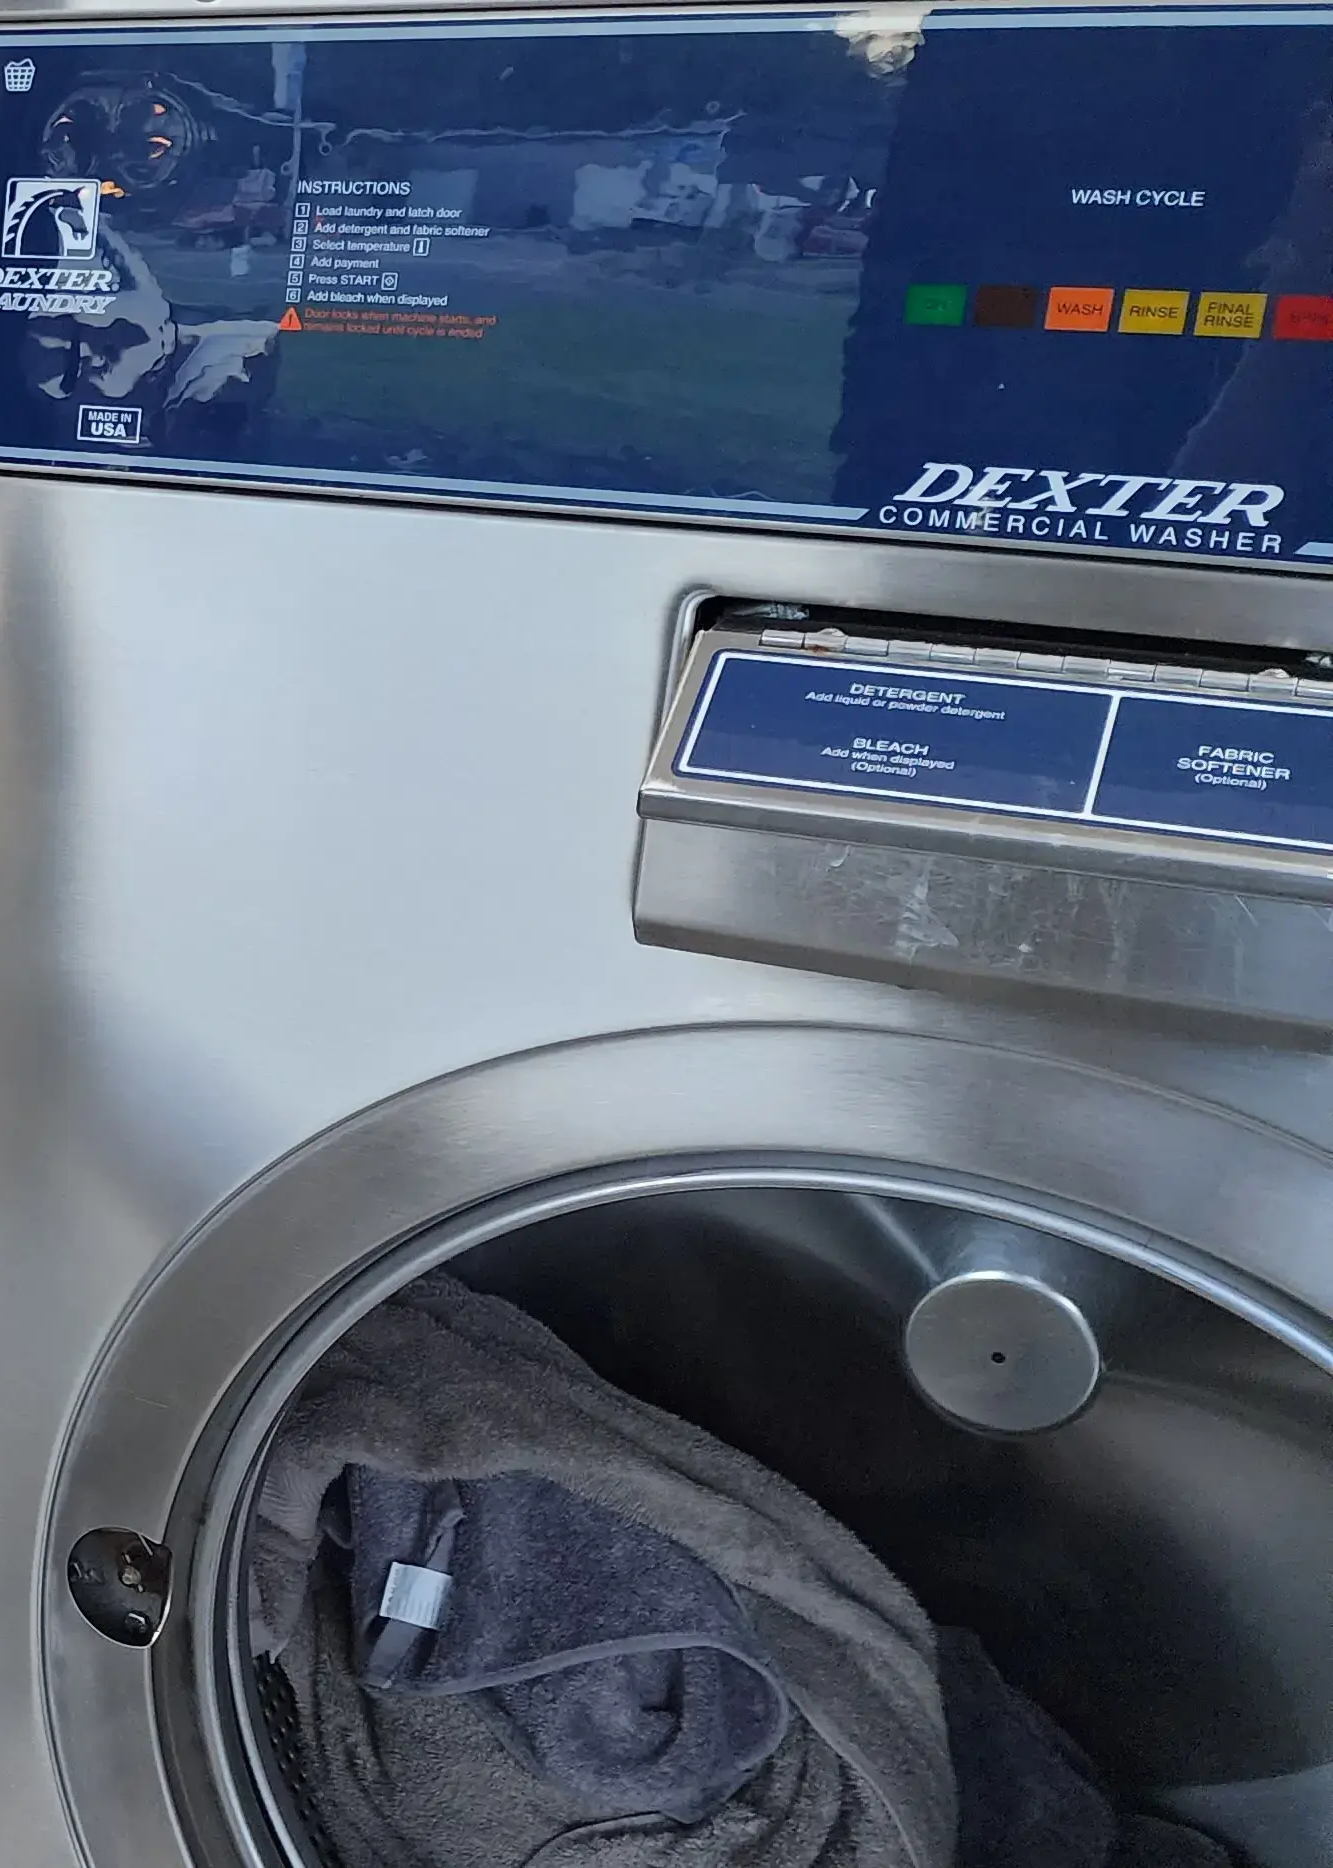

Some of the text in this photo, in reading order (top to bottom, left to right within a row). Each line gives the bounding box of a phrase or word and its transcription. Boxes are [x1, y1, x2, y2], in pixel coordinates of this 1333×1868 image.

[297, 180, 411, 196] INSTRUCTIONS
[1071, 187, 1206, 208] WASH CYCLE
[316, 206, 342, 217] Load
[344, 207, 383, 220] laundry
[386, 208, 406, 218] and
[408, 208, 434, 219] latch
[436, 208, 462, 219] door
[314, 223, 336, 234] Add
[338, 224, 387, 237] detergent
[390, 225, 410, 235] and
[412, 225, 443, 236] fabric
[445, 226, 491, 237] softener
[312, 239, 345, 251] Select
[347, 240, 410, 253] temperature
[310, 256, 332, 268] Add
[334, 258, 380, 271] payment
[308, 274, 338, 285] Press
[340, 275, 379, 286] START
[306, 290, 328, 302] Add
[330, 292, 365, 303] bleach
[366, 293, 395, 304] when
[397, 294, 448, 307] displayed
[304, 308, 330, 319] Door
[332, 309, 358, 320] locks
[361, 310, 389, 321] when
[391, 311, 436, 323] machine
[475, 314, 497, 325] and
[1055, 301, 1104, 317] WASH
[1128, 303, 1179, 320] RINSE
[1206, 300, 1255, 316] FINAL
[1203, 313, 1254, 330] RINSE
[346, 323, 382, 334] locked
[382, 324, 406, 335] until
[407, 325, 434, 337] cycle
[447, 327, 483, 338] ended
[88, 410, 132, 423] MADE IN
[90, 422, 127, 438] USA
[892, 462, 1285, 527] DEXTER
[878, 504, 1283, 555] COMMERCIAL WASHER
[849, 682, 967, 705] DETERGENT
[805, 691, 1006, 721] Add liquid or powder detergent
[852, 737, 930, 756] BLEACH
[1198, 745, 1275, 764] FABRIC
[820, 746, 955, 771] Add when displayed
[850, 760, 917, 779] (Optional)
[1176, 757, 1291, 781] SOFTENER
[1194, 773, 1268, 791] (Optional)
